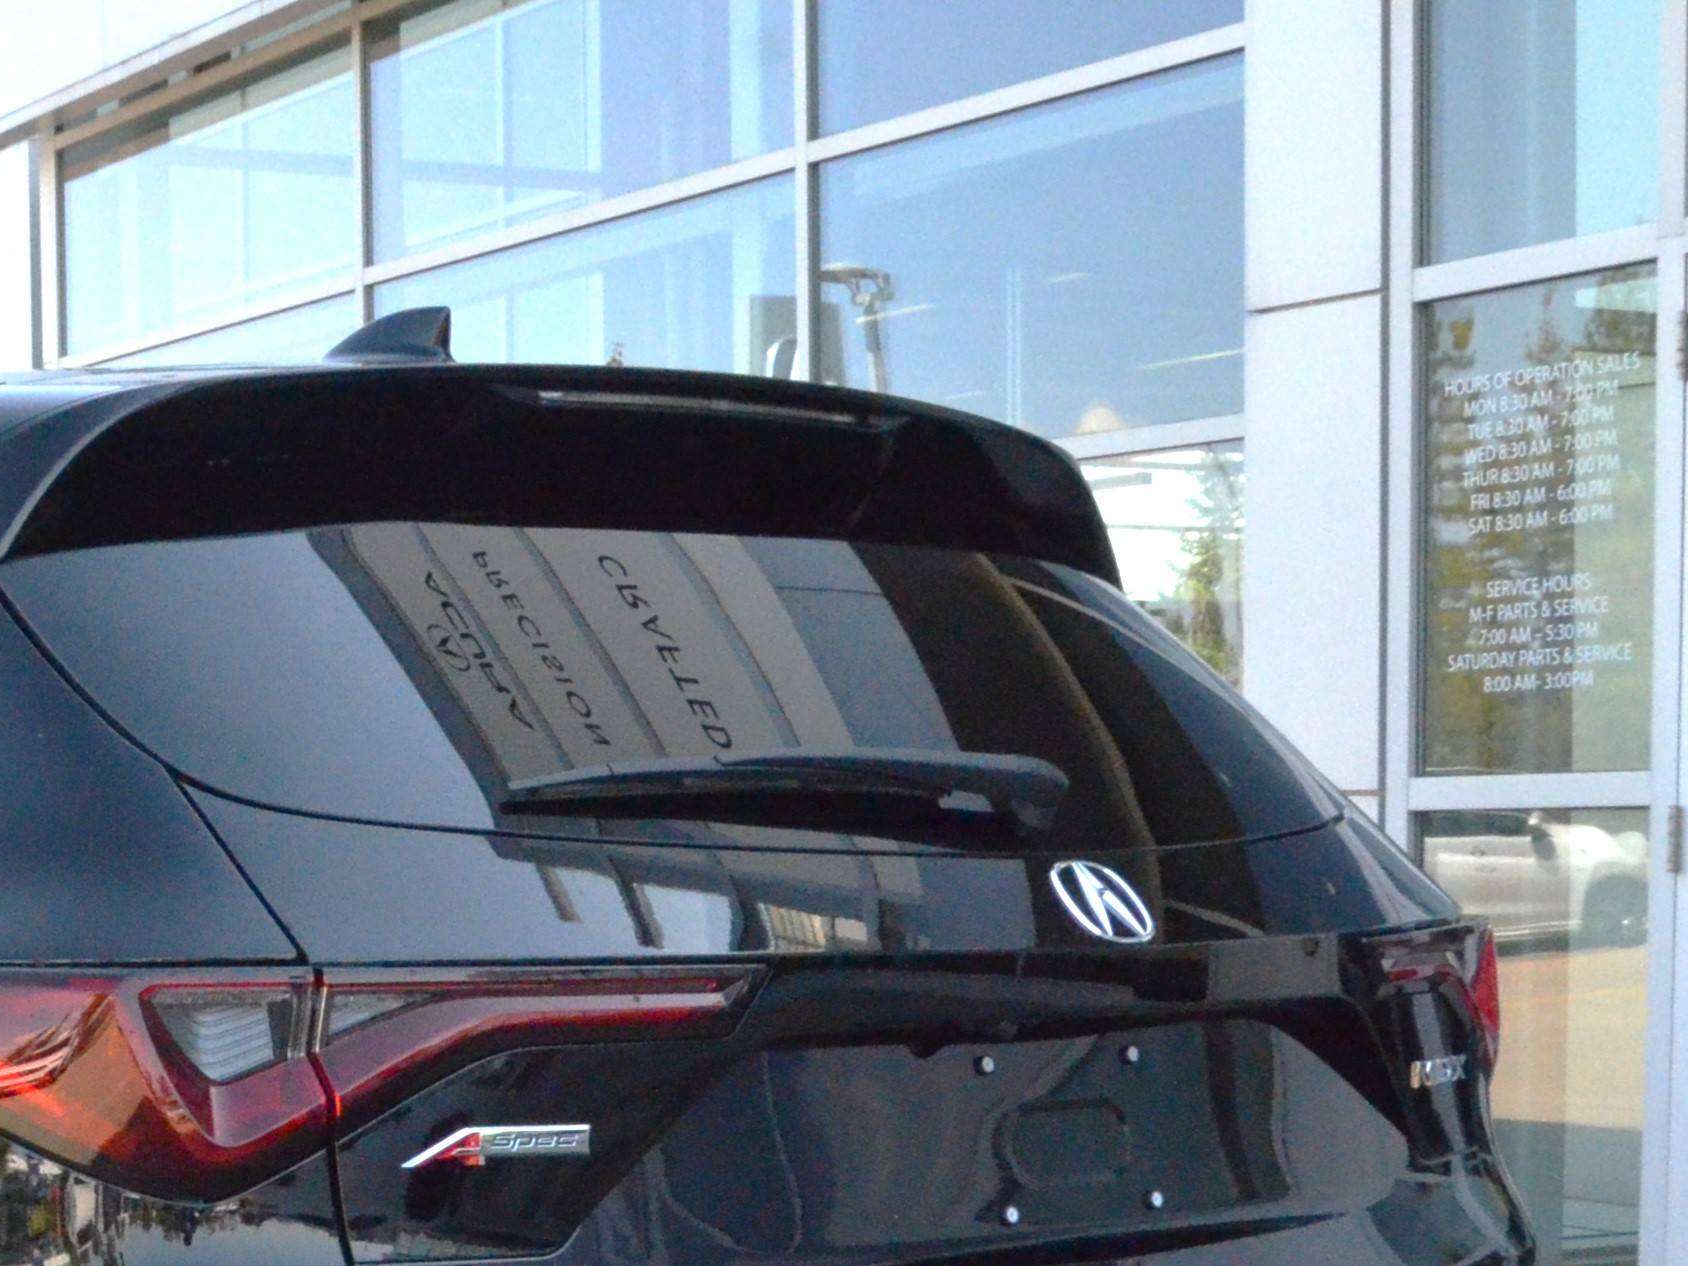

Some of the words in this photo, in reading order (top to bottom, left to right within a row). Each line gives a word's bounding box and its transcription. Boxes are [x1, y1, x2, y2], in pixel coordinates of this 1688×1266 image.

[1443, 374, 1490, 397] HOURS
[1494, 371, 1511, 389] OF
[1514, 361, 1593, 386] OPERATION
[1598, 351, 1641, 373] SALES
[1530, 389, 1553, 406] AM
[1596, 379, 1618, 398] PM
[1527, 414, 1550, 433] AM
[1591, 405, 1613, 422] PM
[1529, 438, 1552, 455] AM
[1595, 430, 1618, 447] PM
[1532, 462, 1555, 479] AM
[1598, 454, 1621, 471] PM
[1523, 487, 1546, 503] AM
[1589, 479, 1612, 496] PM
[1525, 510, 1548, 528] AM
[1591, 503, 1614, 520] PM
[1486, 578, 1539, 599] SERVICE
[1543, 572, 1591, 593] HOURS
[1469, 605, 1494, 623] M-F
[1497, 602, 1537, 622] PARTS
[1541, 601, 1552, 617] &
[1554, 596, 1609, 616] SERVICE
[1509, 626, 1531, 643] AM
[1577, 622, 1599, 638] PM
[1448, 652, 1516, 672] SATURDAY
[1518, 648, 1560, 667] PARTS
[1563, 647, 1575, 664] &
[1576, 642, 1632, 662] SERVICE
